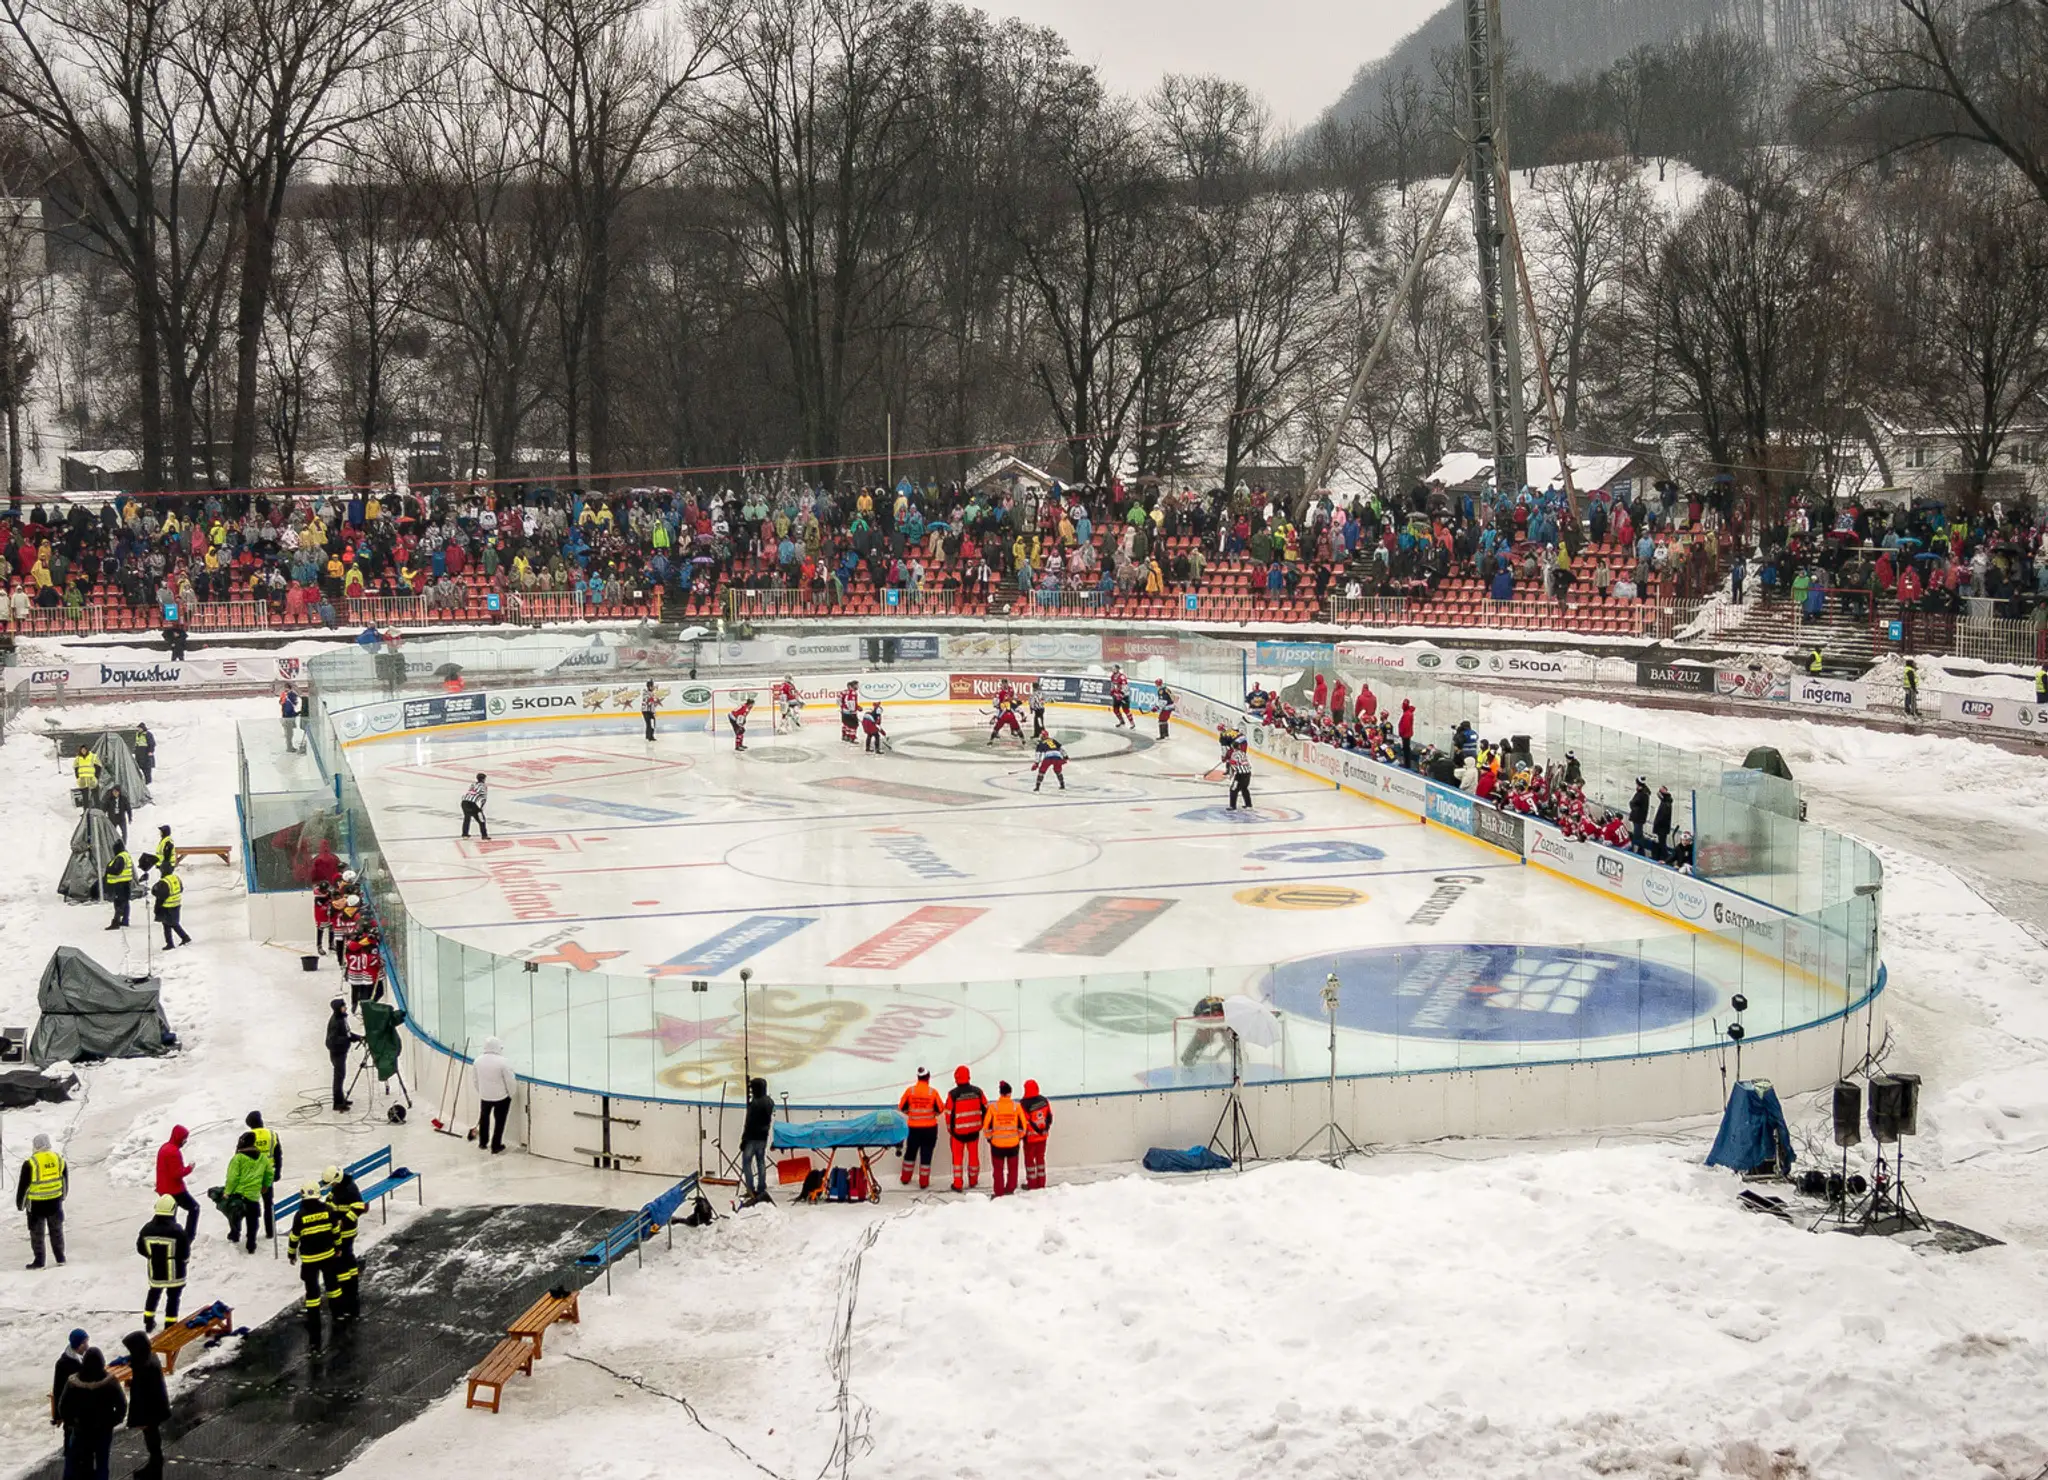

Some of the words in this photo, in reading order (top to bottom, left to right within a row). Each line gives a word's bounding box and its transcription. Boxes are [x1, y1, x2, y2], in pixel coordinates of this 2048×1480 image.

[799, 644, 852, 655] GATORADE
[1275, 647, 1331, 663] Tipsport
[1357, 654, 1404, 668] Kaufland
[1508, 658, 1562, 673] ŠKODA
[100, 661, 181, 687] Doprastav
[512, 695, 577, 710] ŠKODA
[1802, 686, 1852, 704] ingema
[1435, 793, 1471, 826] Tipsport
[1725, 909, 1774, 941] GATORADE
